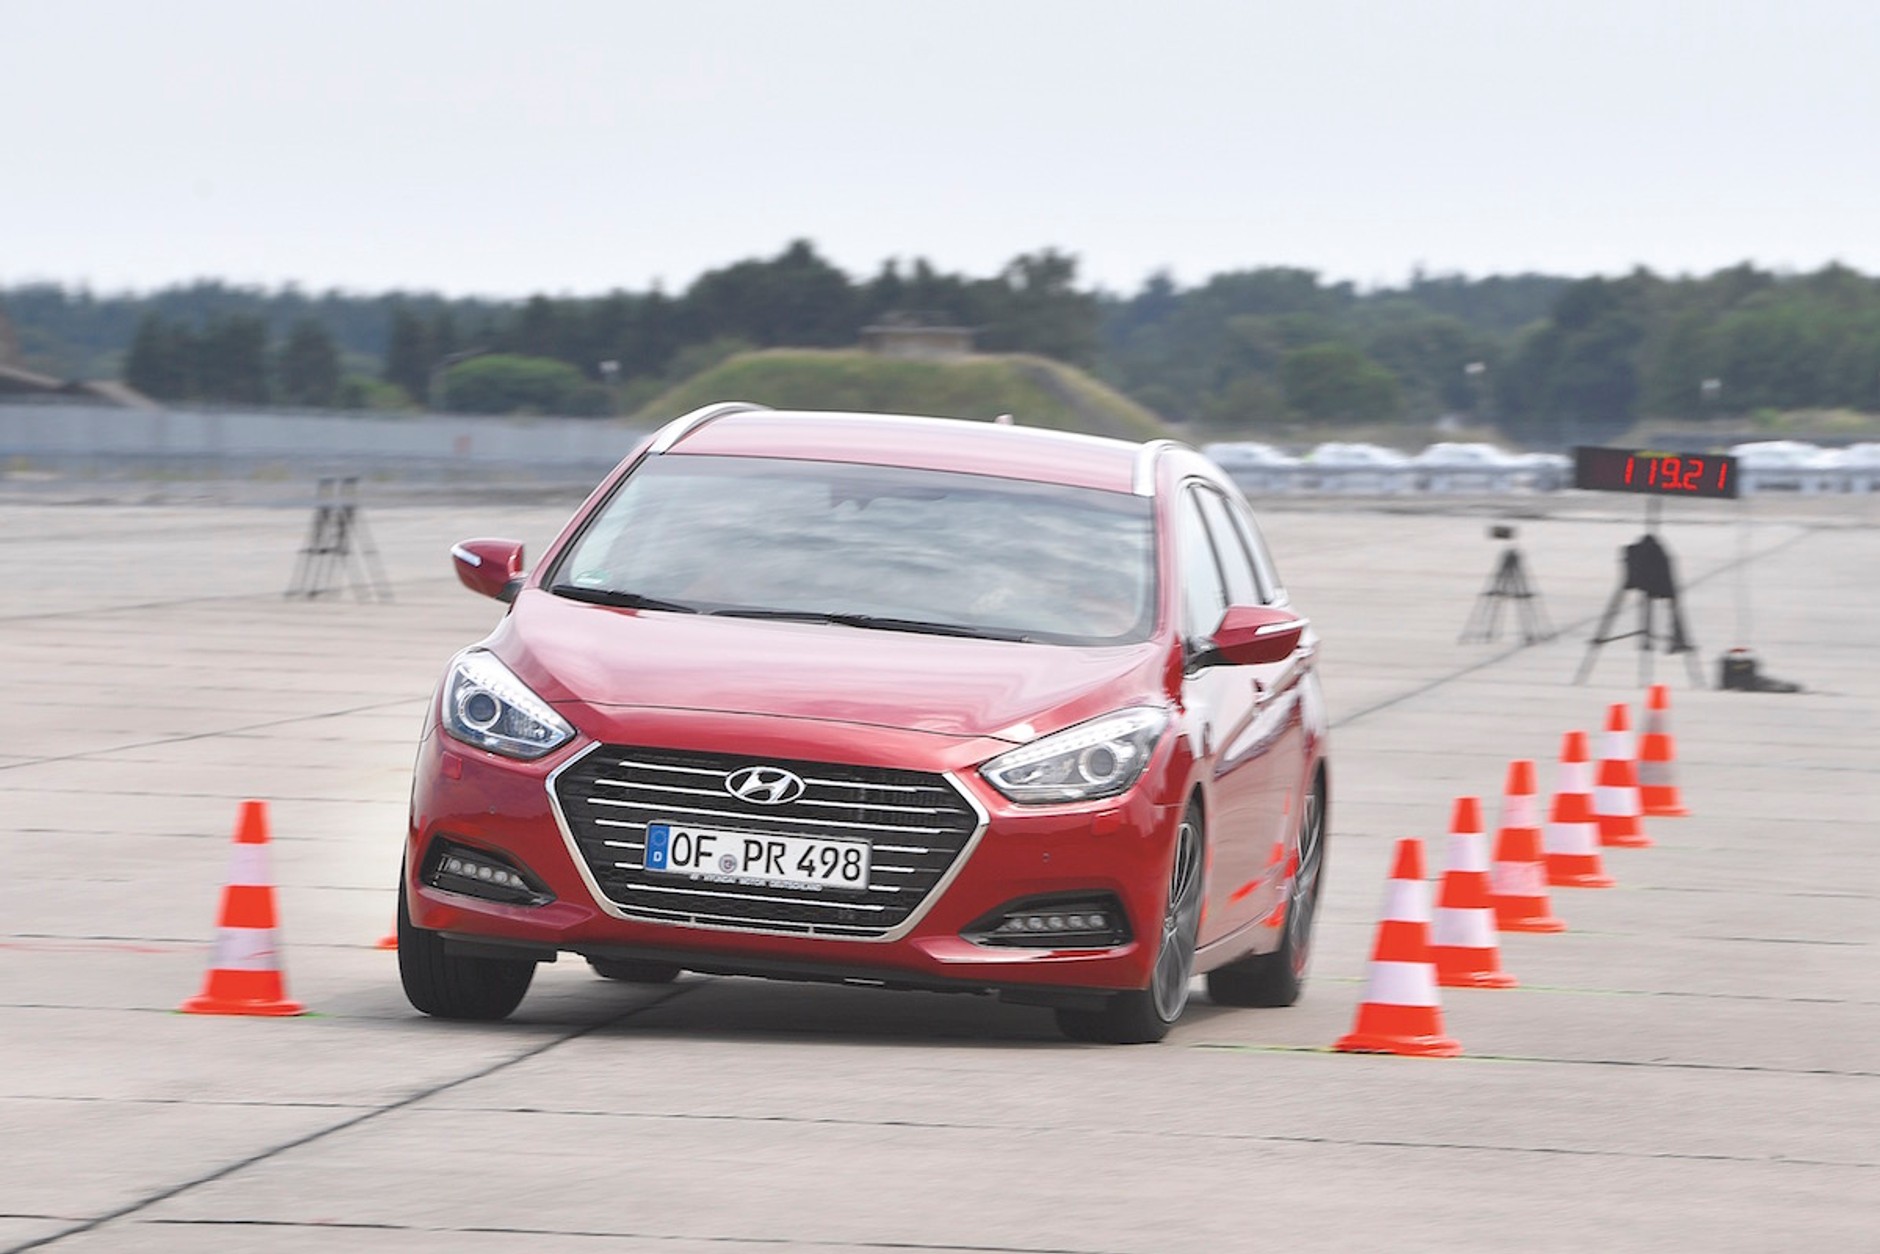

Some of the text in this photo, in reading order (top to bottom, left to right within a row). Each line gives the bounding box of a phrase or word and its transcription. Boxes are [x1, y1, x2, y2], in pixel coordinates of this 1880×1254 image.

[1624, 456, 1728, 491] 119.21
[653, 851, 662, 862] D
[671, 832, 861, 882] OF PR 498
